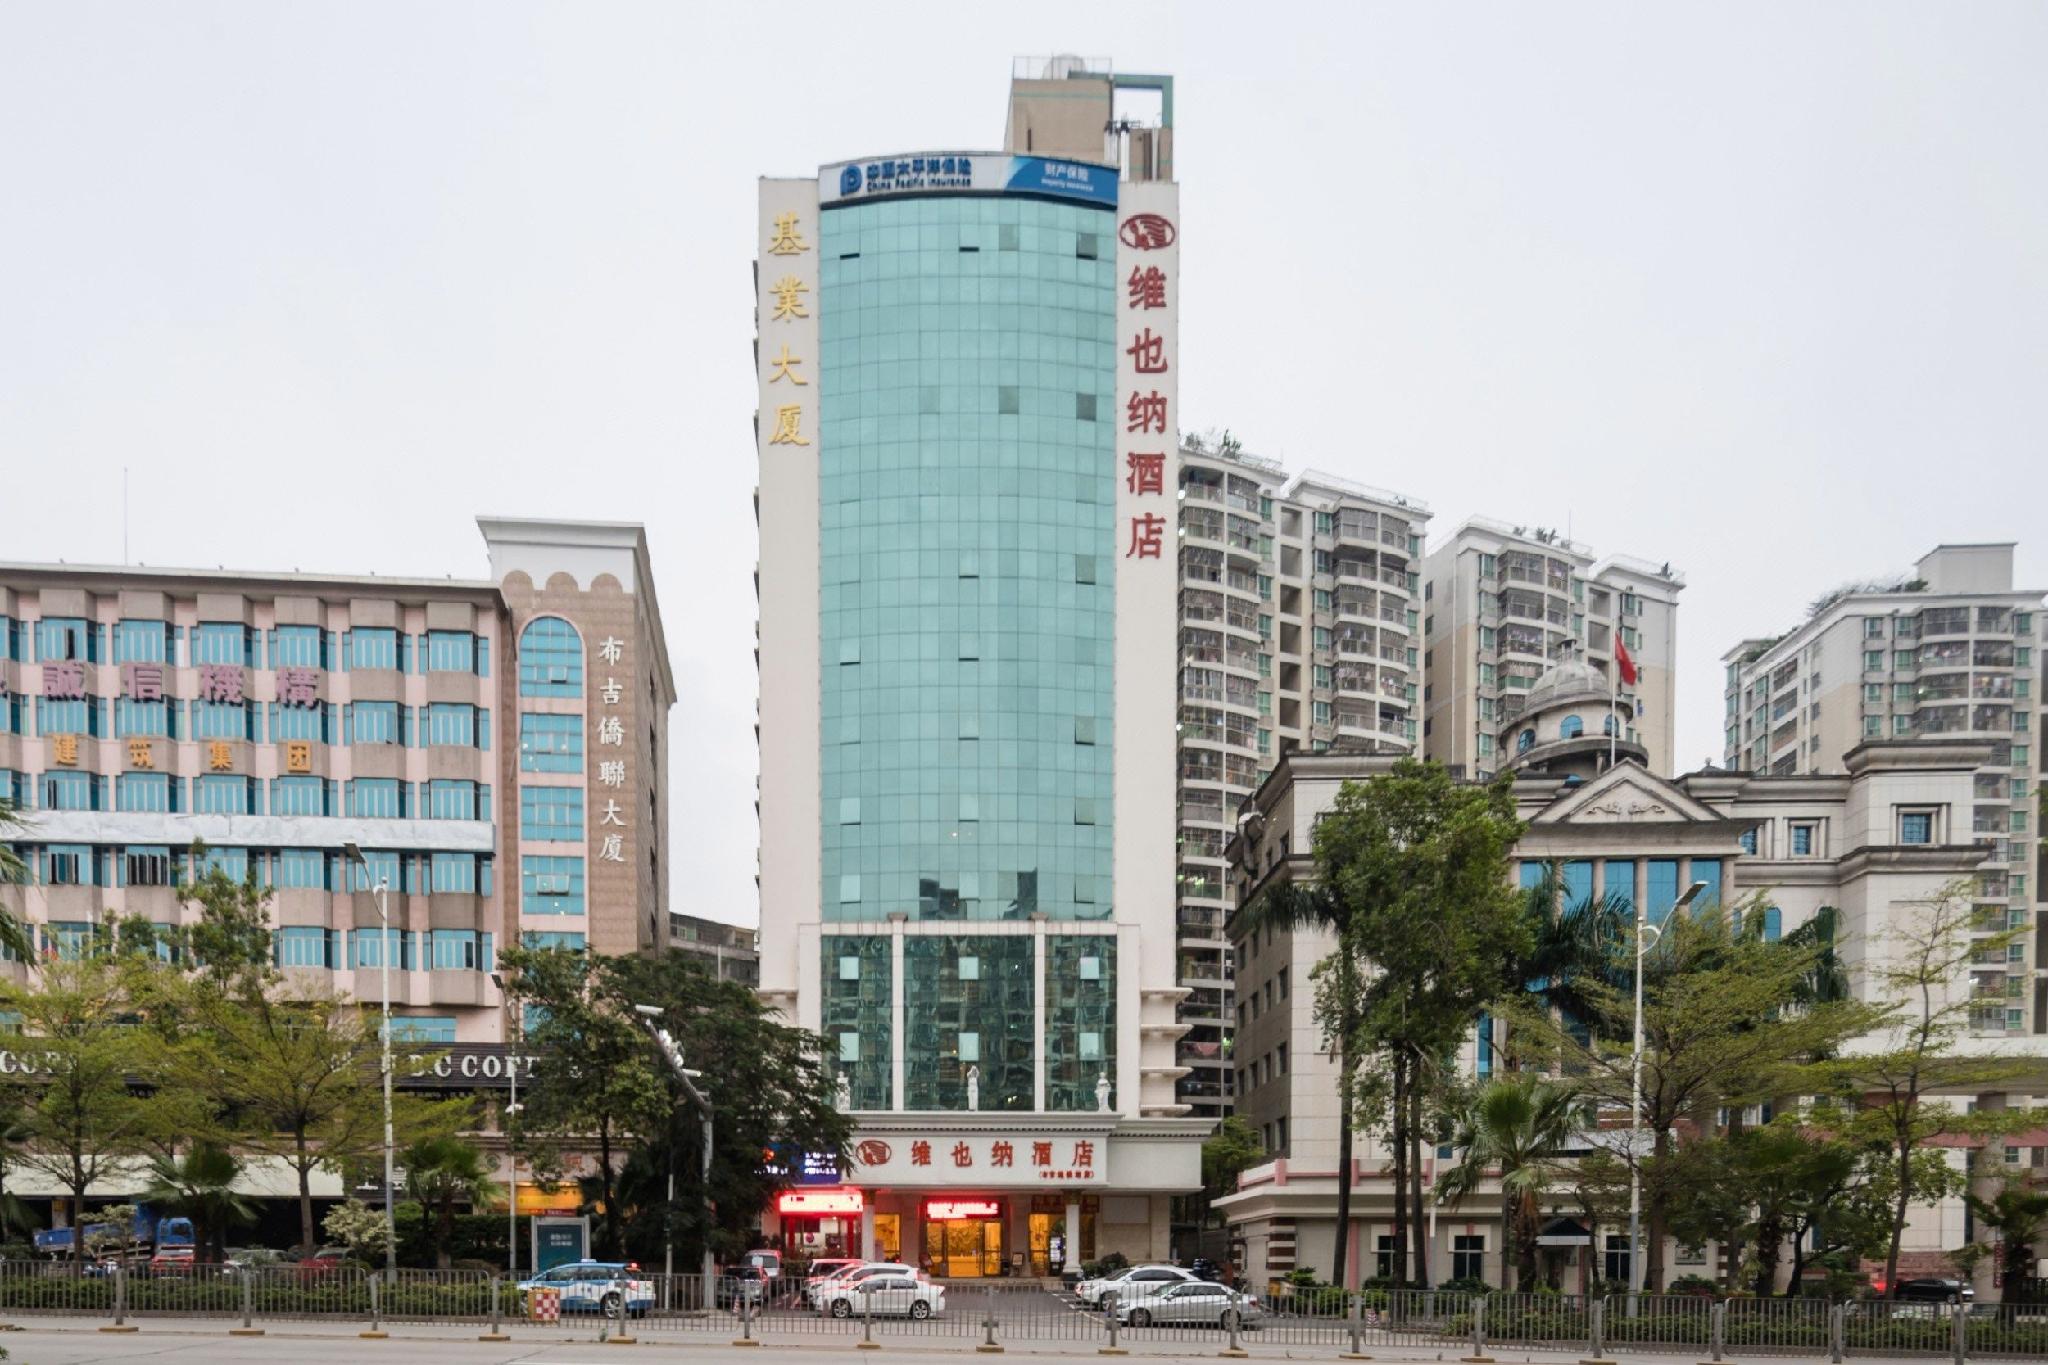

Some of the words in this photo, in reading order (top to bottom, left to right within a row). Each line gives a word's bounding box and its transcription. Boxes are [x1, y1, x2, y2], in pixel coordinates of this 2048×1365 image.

[1126, 264, 1168, 560] 维也纳酒店
[910, 1140, 1095, 1168] 维也纳酒店
